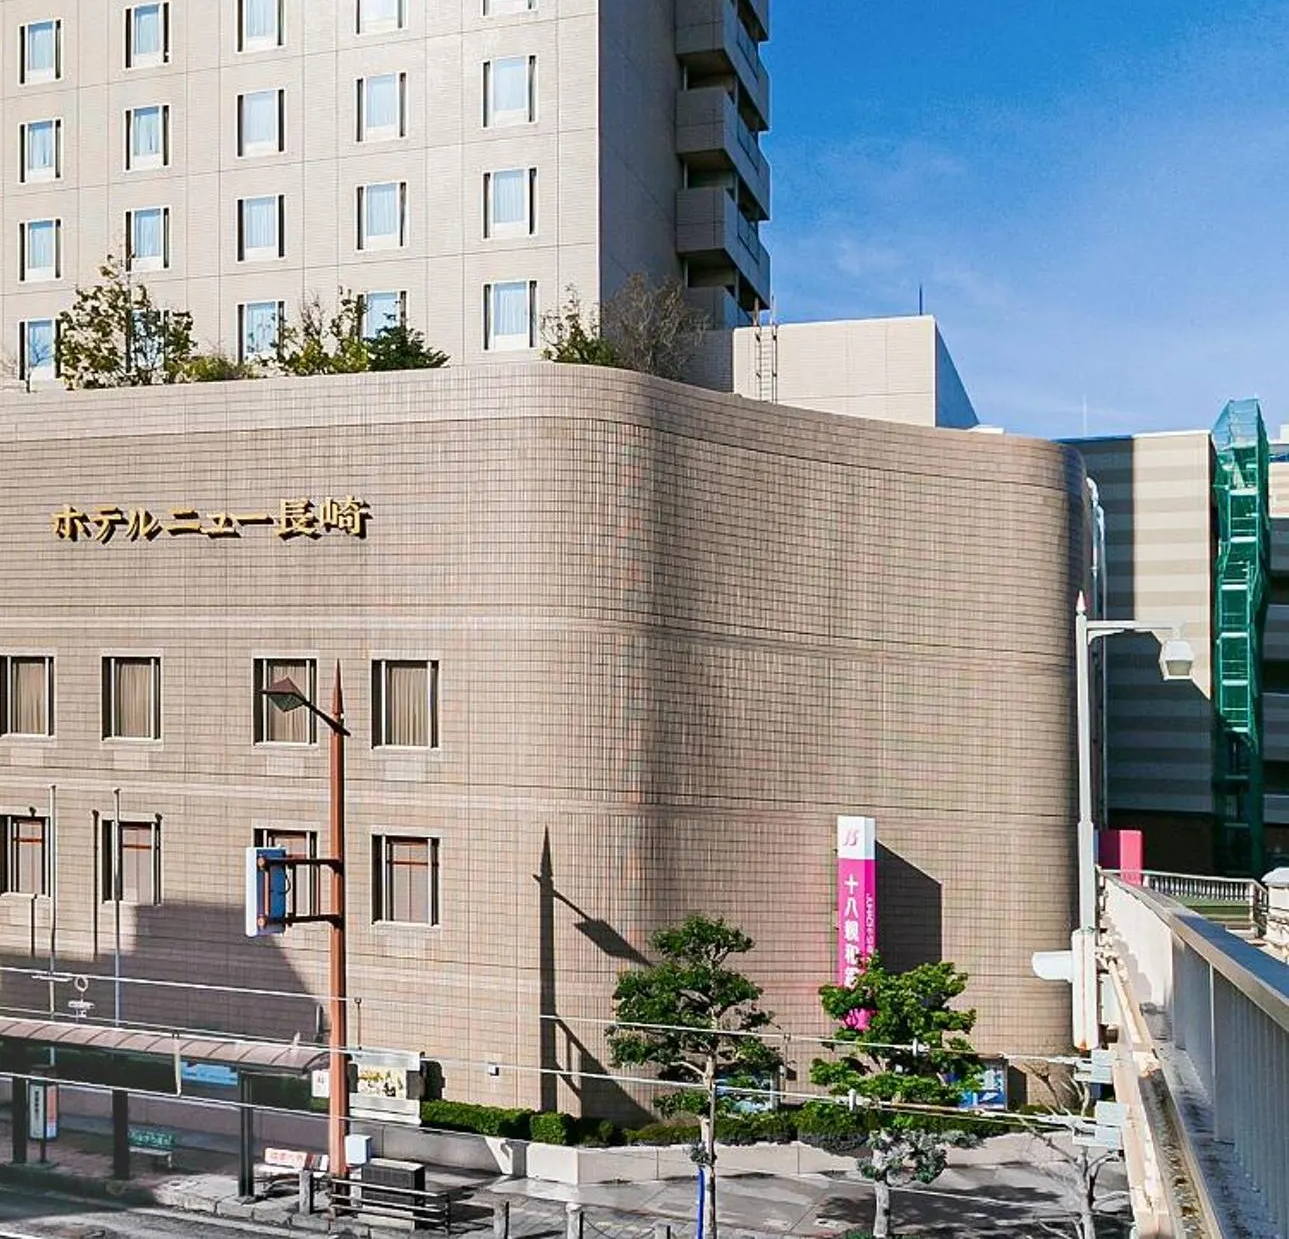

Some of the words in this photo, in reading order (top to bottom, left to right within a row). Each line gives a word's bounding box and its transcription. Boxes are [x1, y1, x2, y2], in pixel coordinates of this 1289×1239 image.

[52, 495, 371, 542] ホテルニュー長崎
